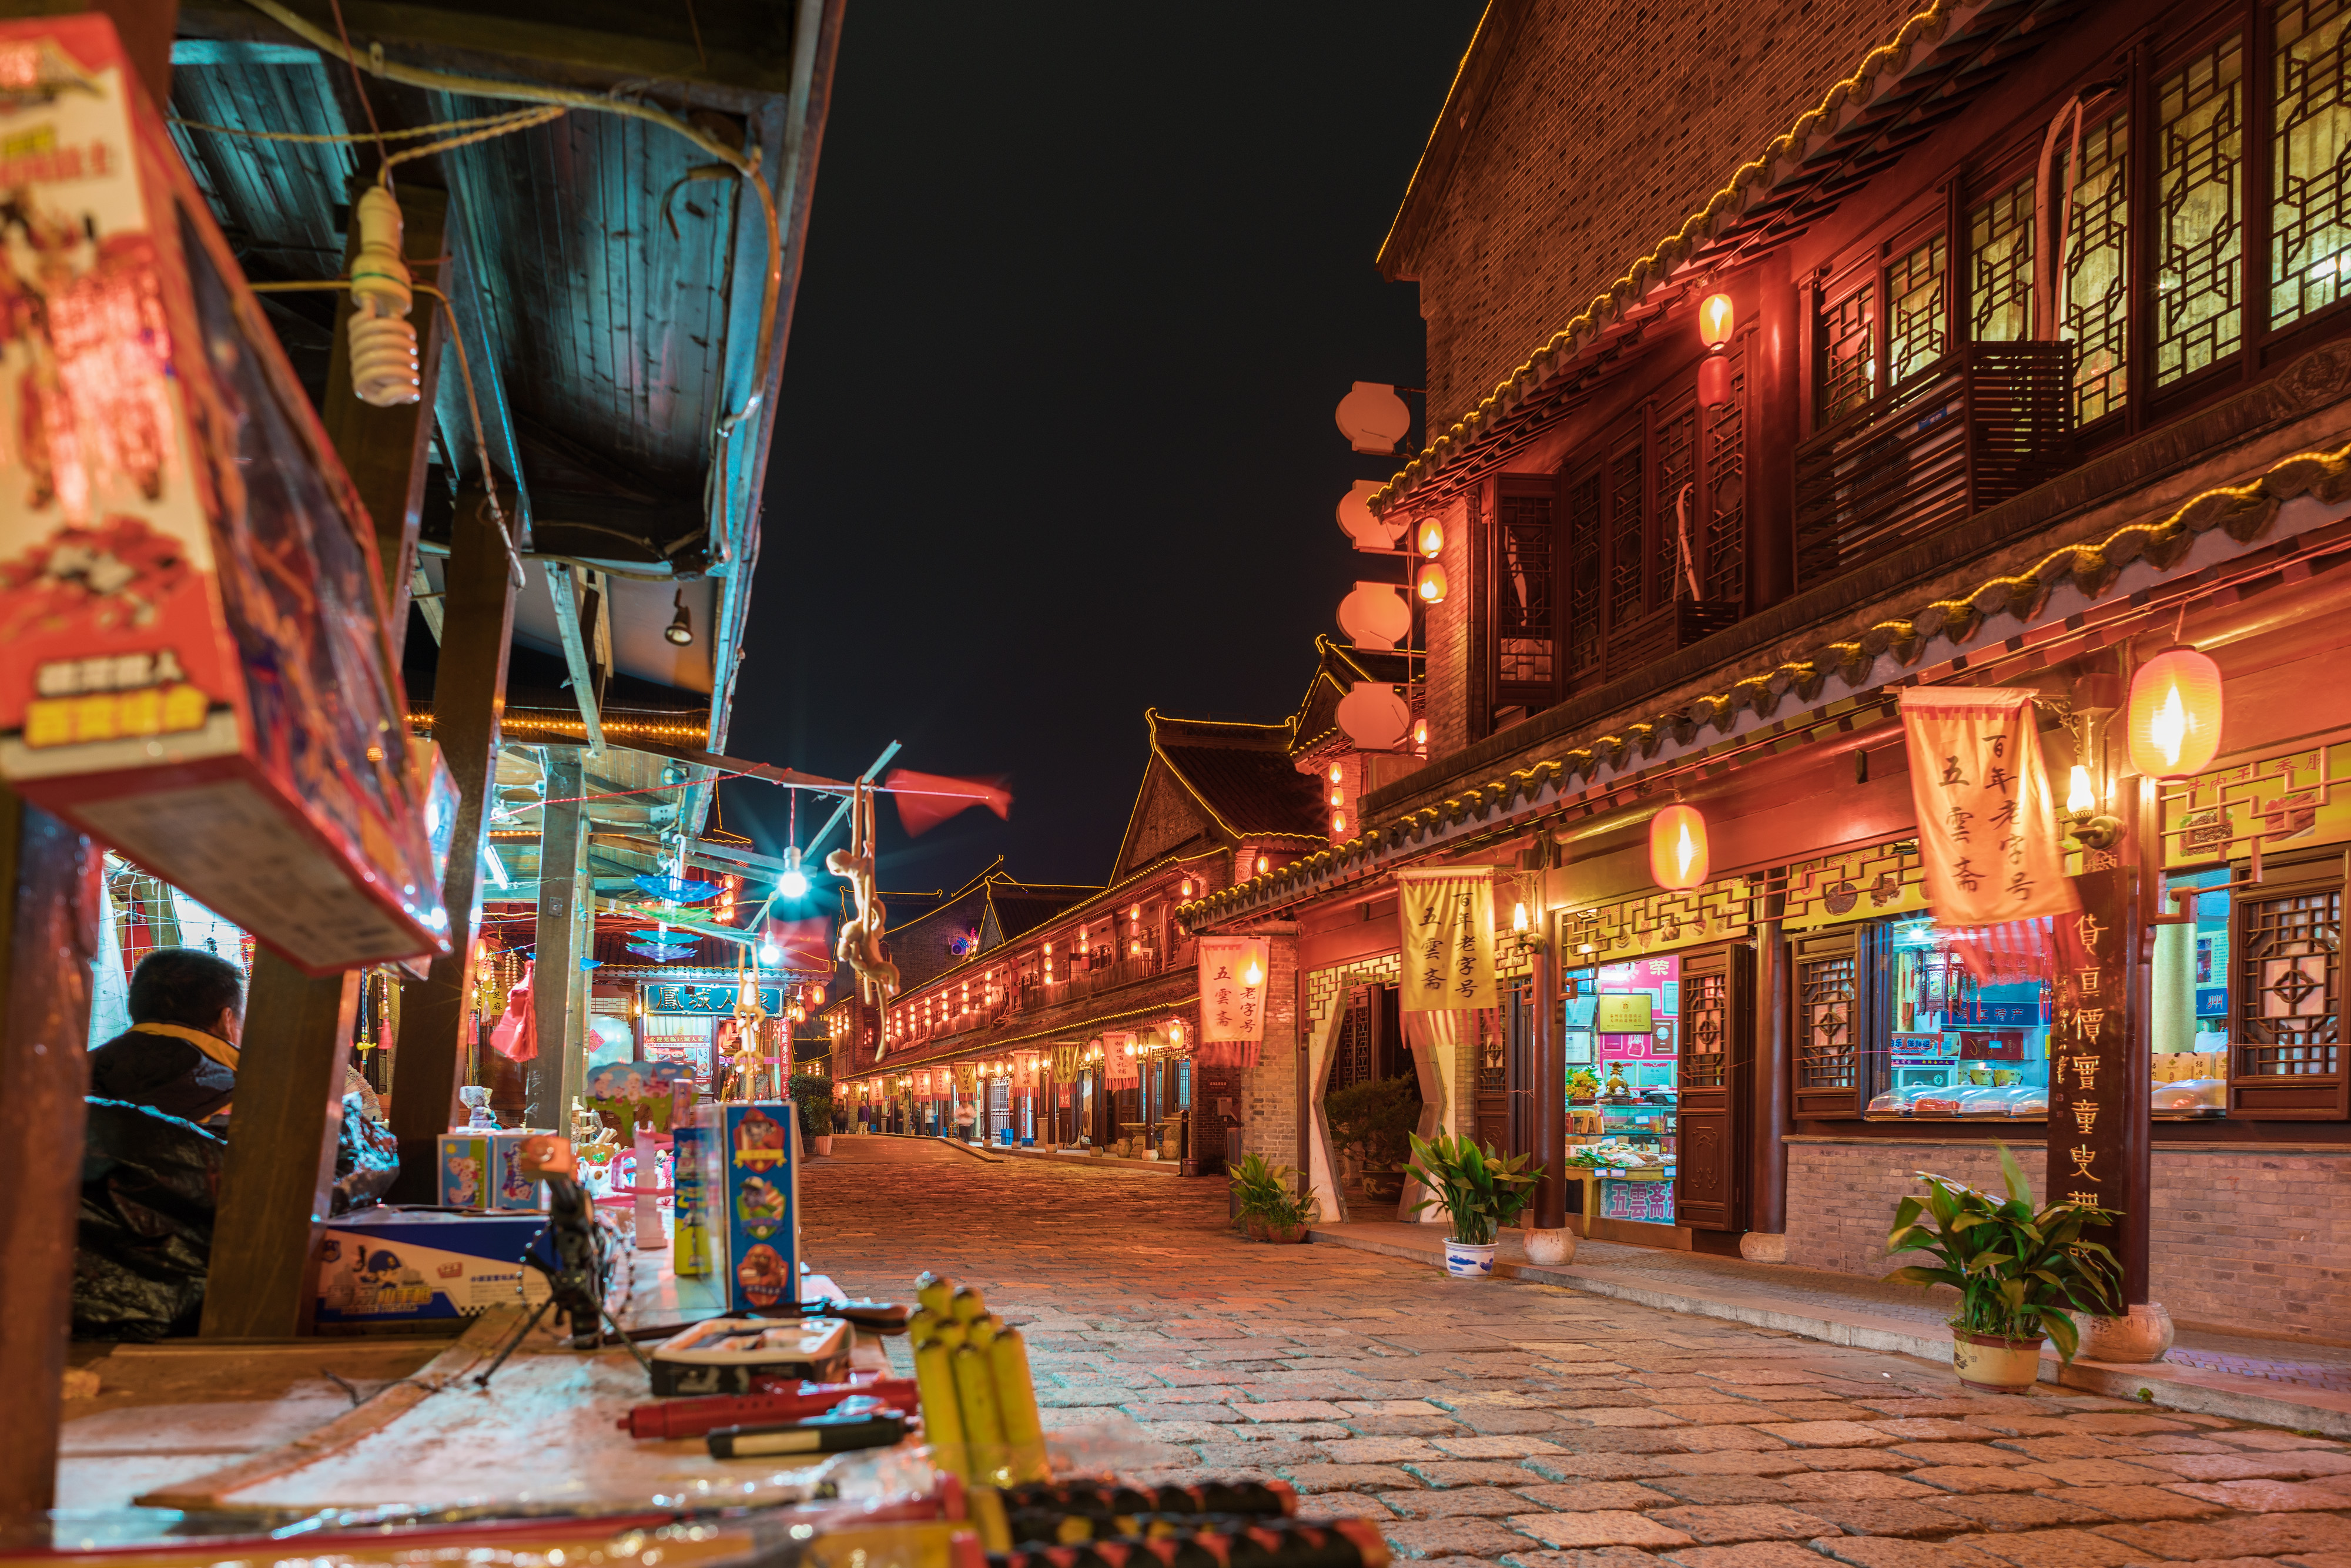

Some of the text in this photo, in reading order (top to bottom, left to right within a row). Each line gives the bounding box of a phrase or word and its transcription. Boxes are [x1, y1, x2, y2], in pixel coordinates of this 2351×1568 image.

[1982, 735, 2037, 901] 百年老字号
[1451, 892, 1478, 998] 百年老字号
[1648, 959, 1670, 976] 荣
[1060, 1095, 1070, 1105] 水饺
